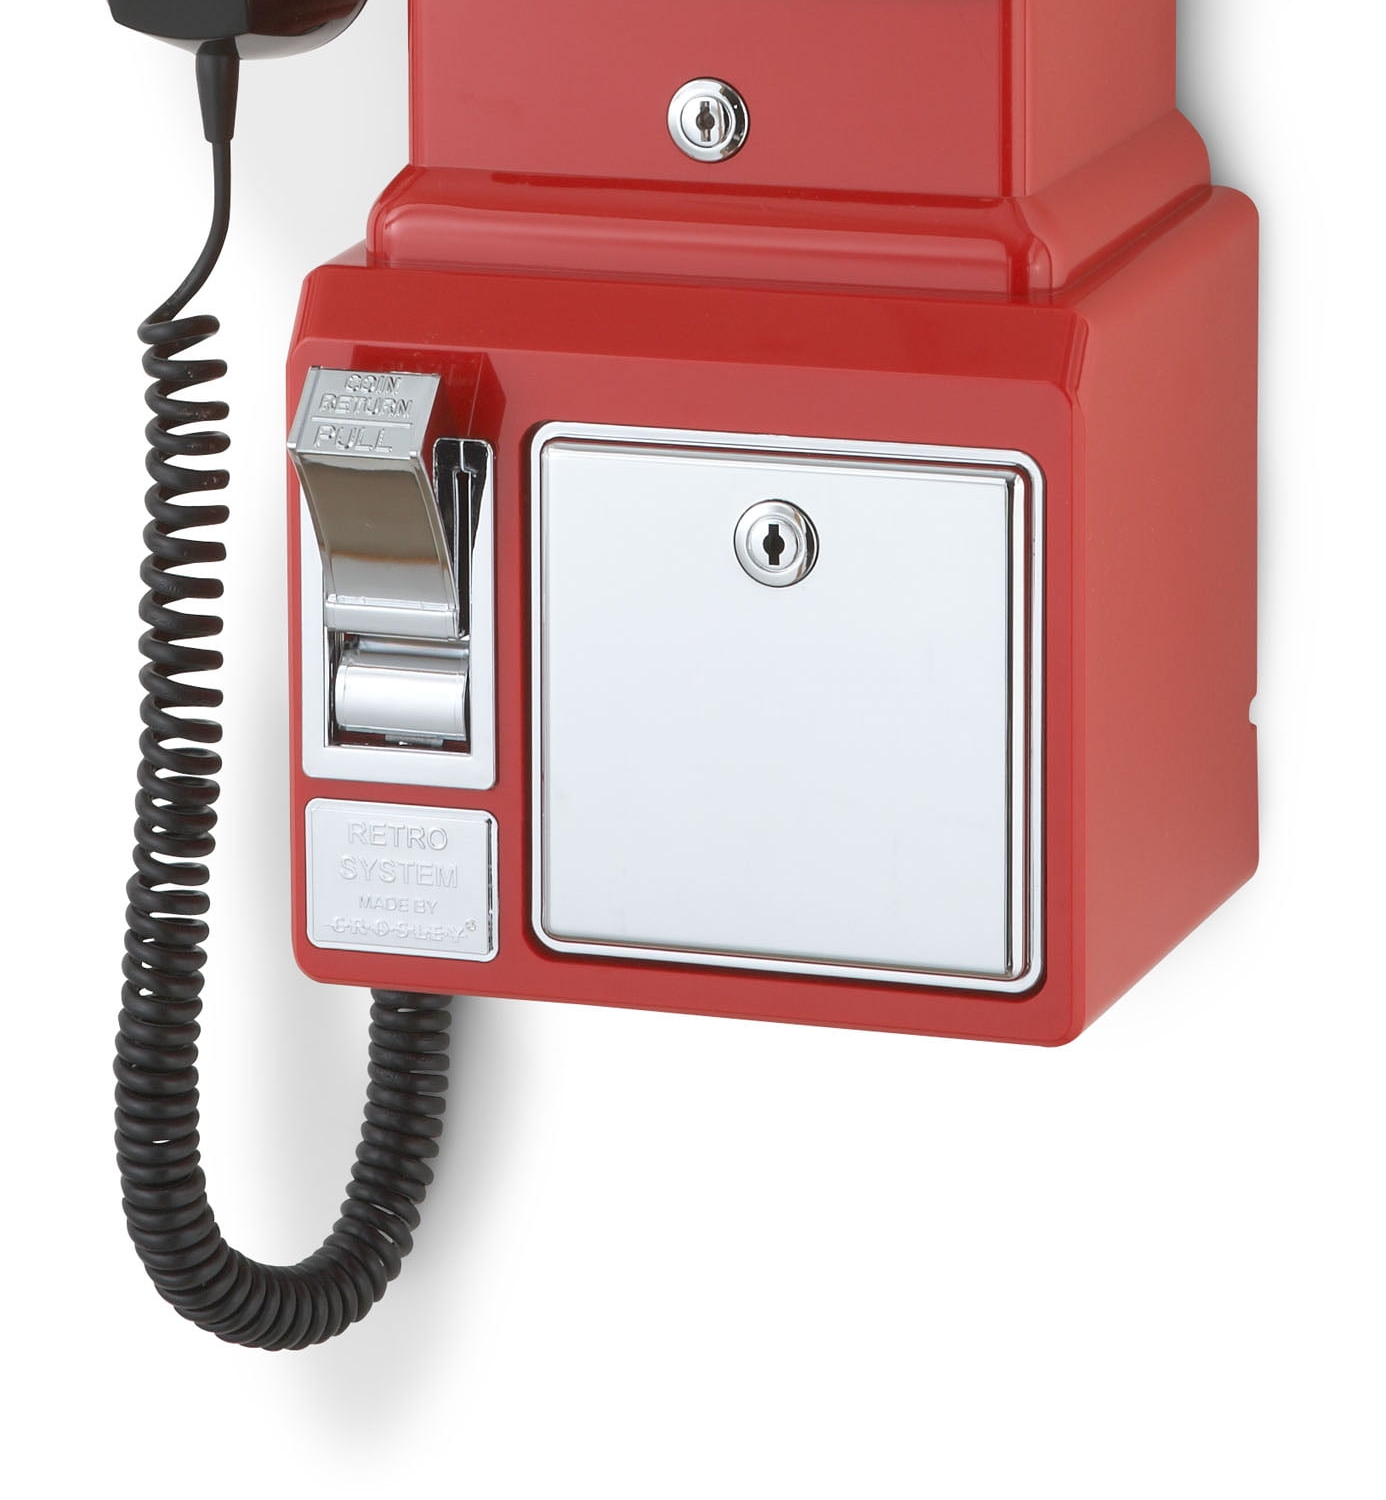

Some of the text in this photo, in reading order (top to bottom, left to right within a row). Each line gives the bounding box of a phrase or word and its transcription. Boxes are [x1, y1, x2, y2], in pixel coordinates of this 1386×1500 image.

[344, 374, 402, 395] COIN
[319, 393, 413, 417] RETURN
[314, 425, 392, 453] PULL
[348, 821, 448, 851] RETRO
[339, 854, 458, 888] SYSTEM
[360, 894, 437, 914] MADE BY
